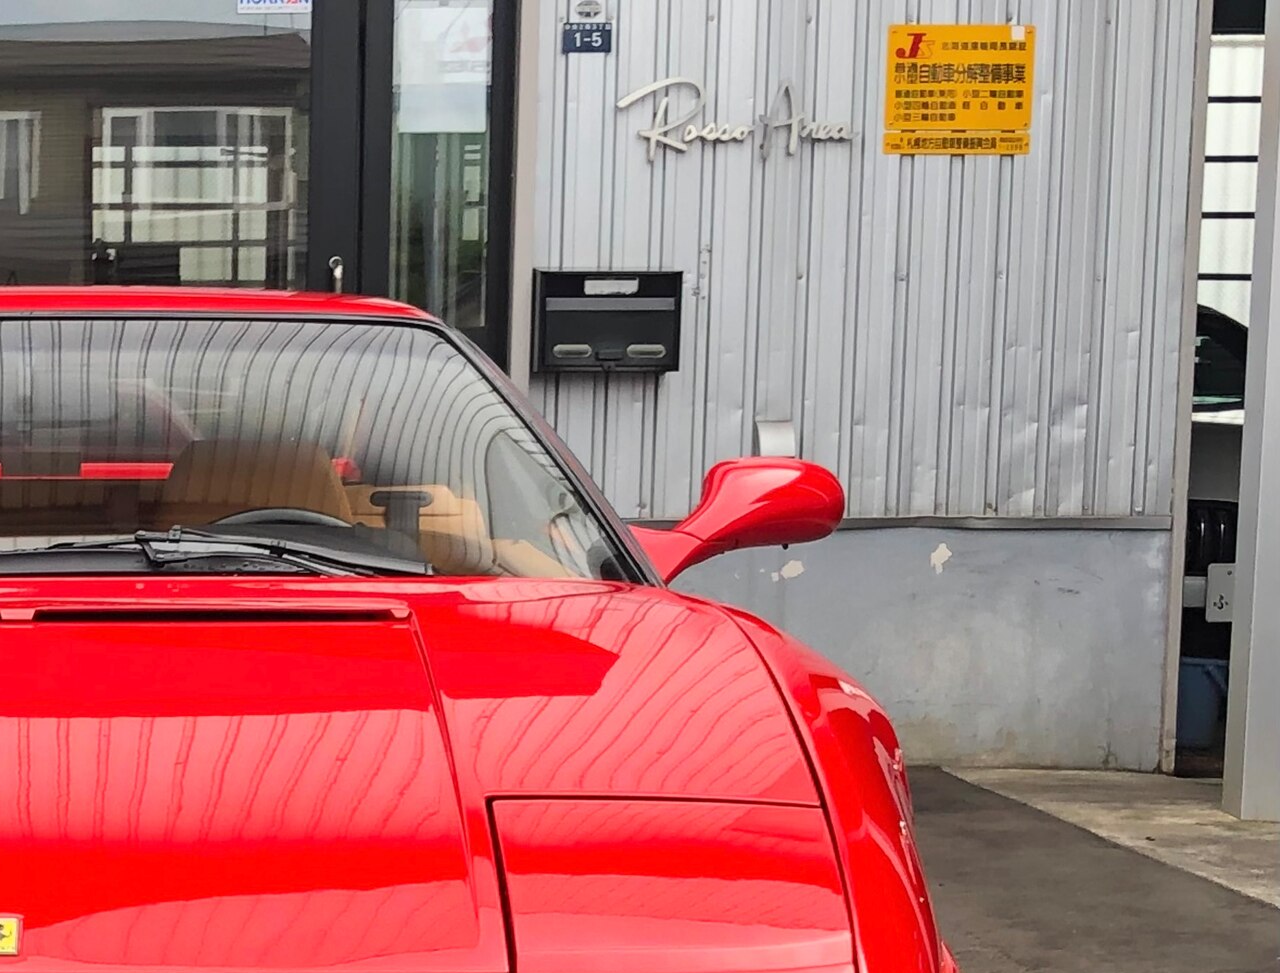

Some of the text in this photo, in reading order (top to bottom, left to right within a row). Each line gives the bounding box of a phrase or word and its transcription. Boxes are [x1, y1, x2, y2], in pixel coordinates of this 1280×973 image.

[574, 31, 603, 48] 1-5
[616, 77, 859, 163] Rosso Area
